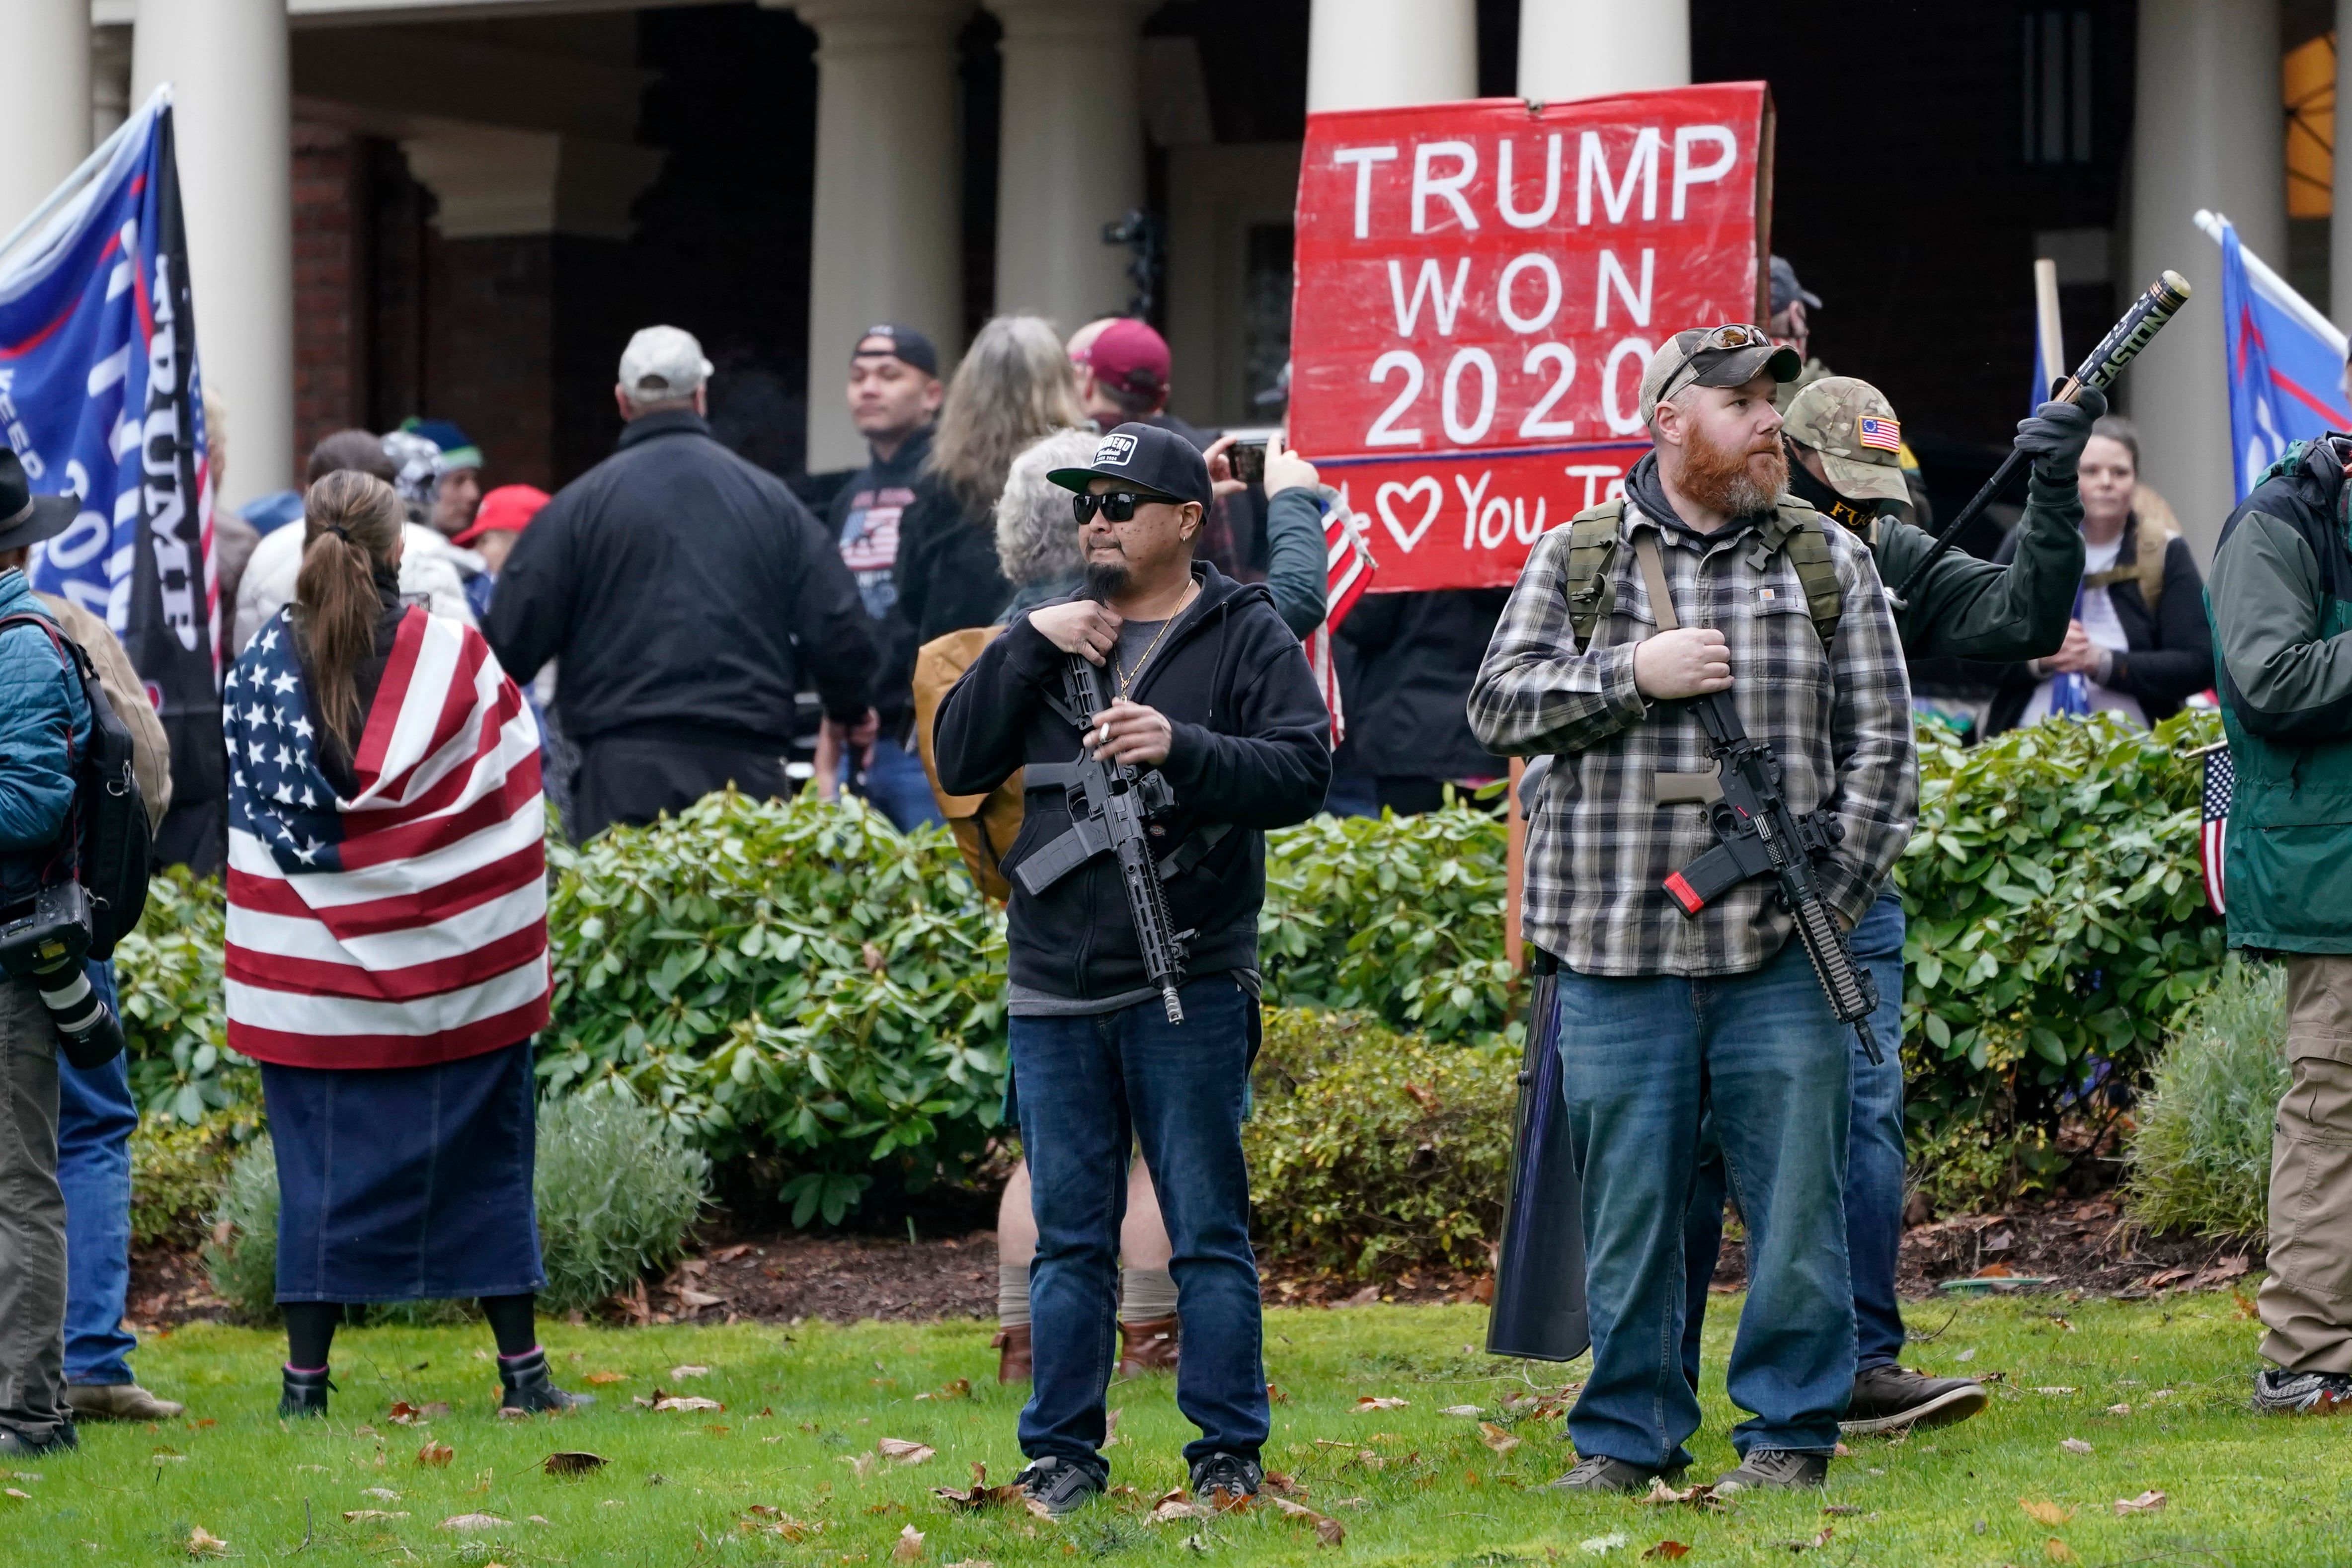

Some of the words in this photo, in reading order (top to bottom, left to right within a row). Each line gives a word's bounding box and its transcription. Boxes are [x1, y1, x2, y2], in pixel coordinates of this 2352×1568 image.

[1334, 125, 1738, 239] TRUMP
[1388, 248, 1655, 337] WON
[1365, 337, 1654, 447] 2020
[2087, 306, 2172, 390] EASTON
[1455, 470, 1545, 551] You
